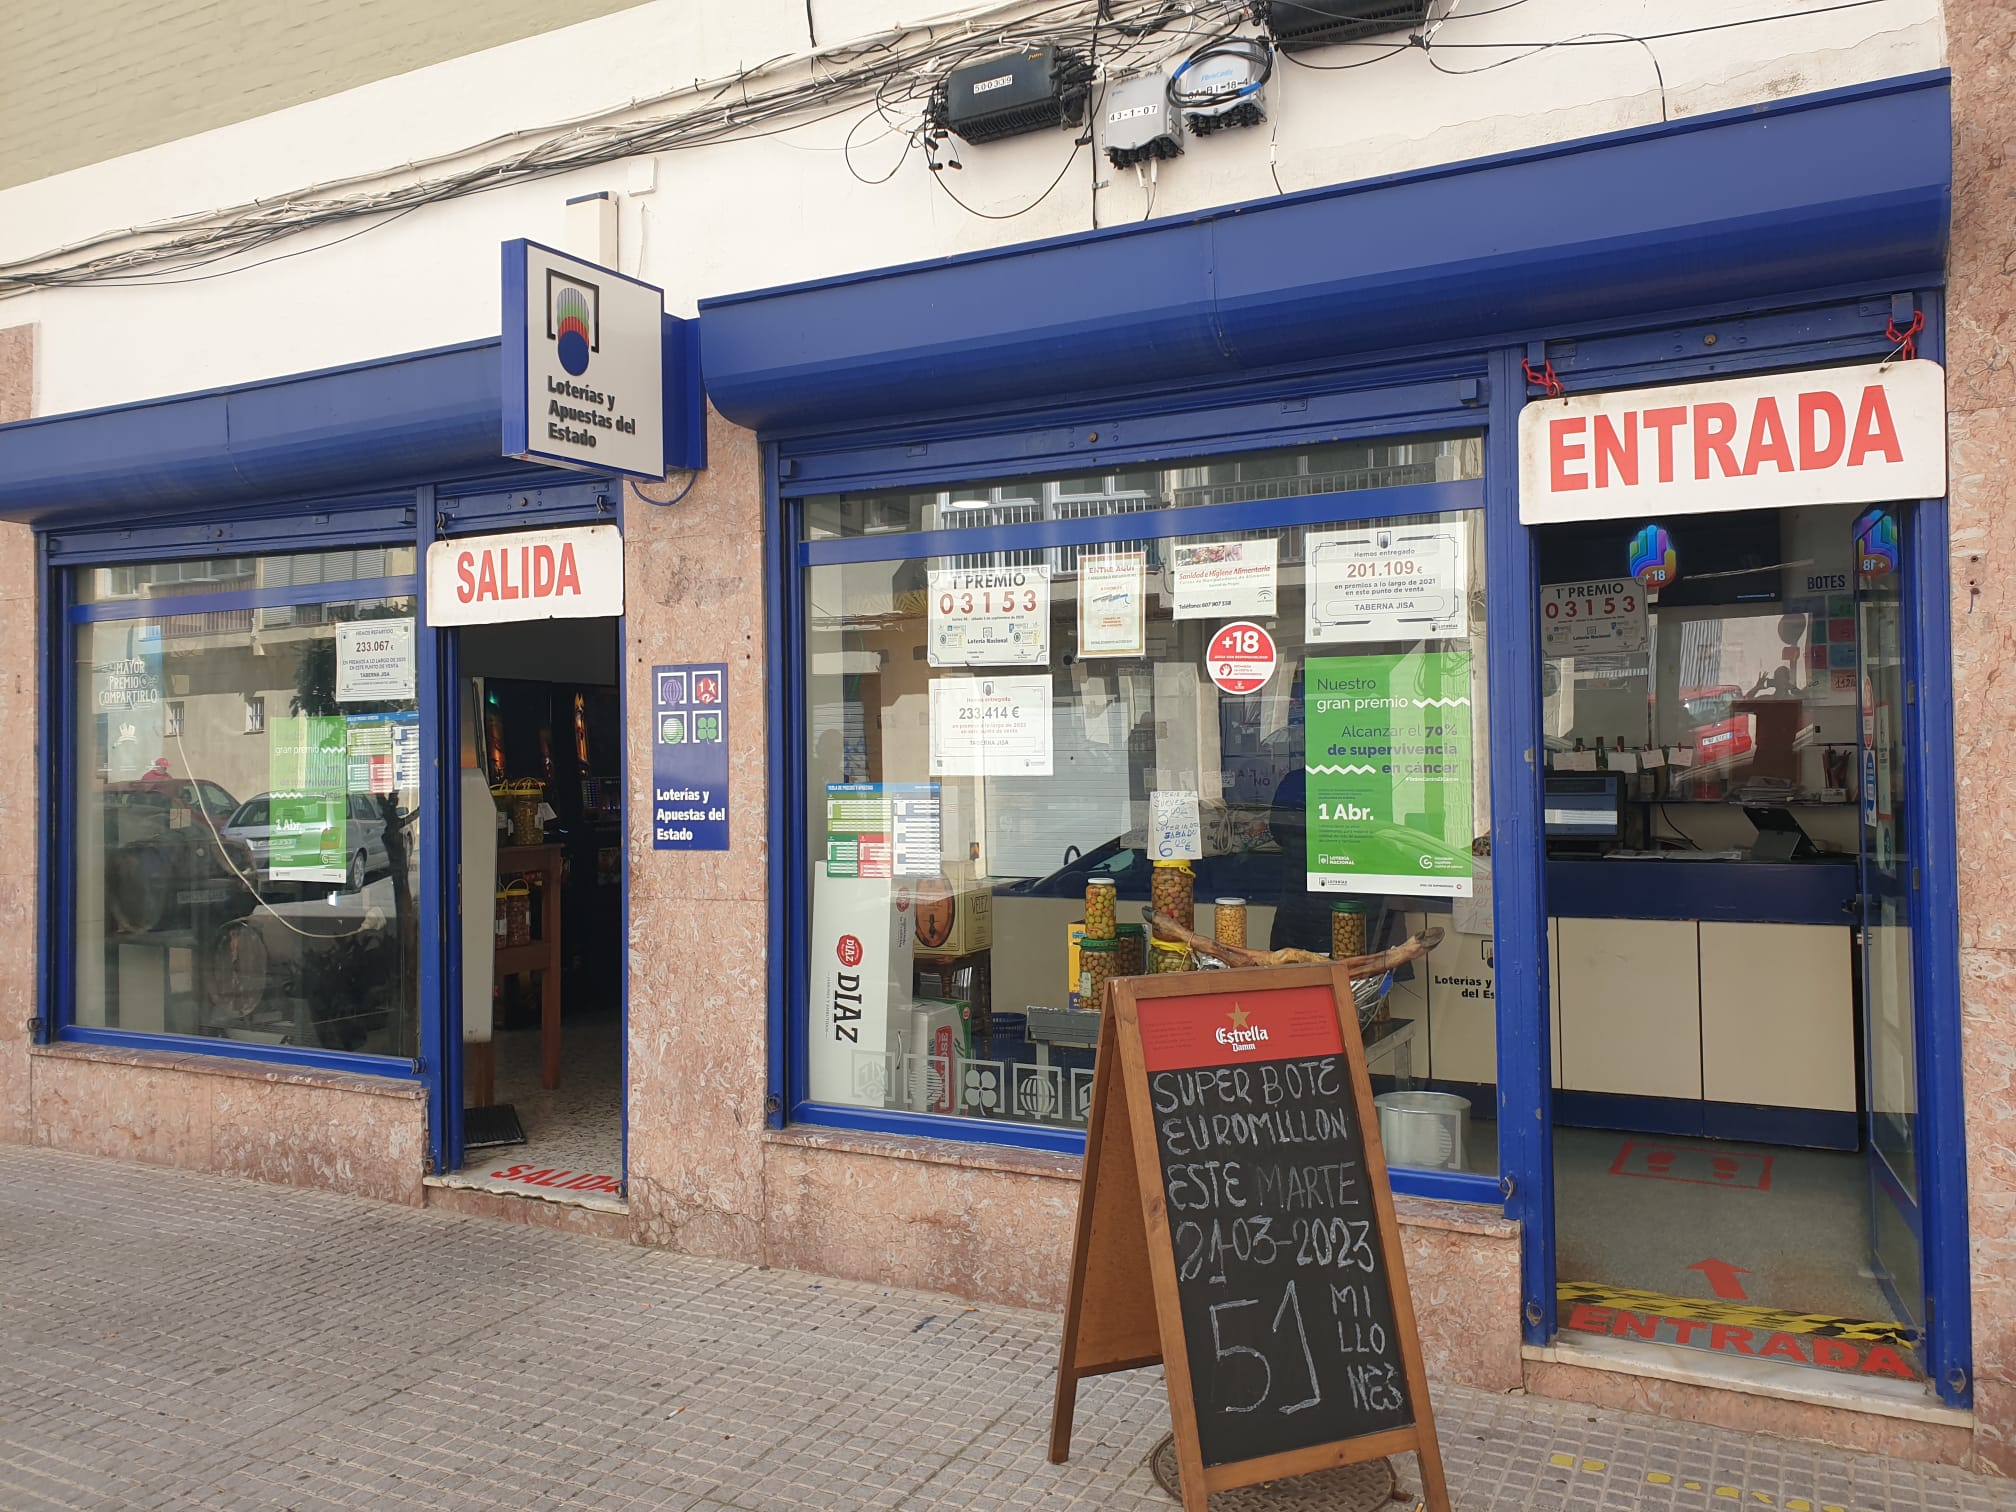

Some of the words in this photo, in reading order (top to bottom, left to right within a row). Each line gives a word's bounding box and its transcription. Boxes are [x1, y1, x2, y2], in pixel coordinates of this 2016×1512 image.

[1110, 105, 1157, 121] 43-1-07
[547, 375, 604, 405] Loterías
[607, 393, 615, 412] y
[548, 400, 613, 430] Apuestas
[616, 414, 636, 435] del
[548, 421, 597, 448] Estado
[1549, 384, 1904, 493] ENTRADA
[1379, 548, 1415, 557] entregado
[456, 542, 581, 604] SALIDA
[1179, 571, 1205, 580] Sanidad
[1209, 569, 1232, 578] Higiene
[1233, 565, 1270, 575] Alimentaria
[1347, 560, 1415, 579] 201.109
[1417, 566, 1423, 574] €
[966, 573, 1026, 589] PREMIO
[1344, 582, 1372, 591] premios
[1388, 580, 1407, 588] largo
[1807, 575, 1846, 590] BOTES
[1371, 588, 1392, 596] punto
[1568, 583, 1624, 598] PREMIO
[940, 590, 1037, 615] 03153
[1355, 602, 1394, 611] TABERNA
[1396, 601, 1414, 609] JISA
[1545, 595, 1636, 619] 03153
[356, 640, 389, 653] 233.067
[1222, 630, 1259, 654] +18
[116, 660, 145, 675] MAYOR
[109, 675, 139, 690] PREMIO
[1317, 678, 1377, 691] Nuestro
[98, 689, 158, 706] COMPARTIRLO
[1317, 699, 1350, 713] gran
[1354, 695, 1409, 712] premio
[959, 706, 1008, 720] 233.414
[1012, 706, 1020, 718] €
[1341, 725, 1405, 738] Alcanzar
[1408, 723, 1421, 737] el
[1425, 723, 1458, 738] 70%
[1327, 743, 1347, 756] de
[1350, 745, 1458, 758] supervivencia
[1381, 764, 1401, 774] en
[1404, 761, 1459, 774] cáncer
[657, 788, 700, 800] Loterías
[703, 790, 709, 804] y
[657, 808, 706, 823] Apuestas
[708, 808, 726, 820] del
[1318, 804, 1330, 820] 1
[1333, 803, 1374, 820] Abr.
[275, 819, 282, 830] 1
[283, 818, 302, 832] Abr.
[657, 828, 693, 841] Estado
[845, 938, 855, 962] DIAZ
[1485, 978, 1492, 990] y
[1461, 989, 1479, 999] del
[833, 972, 862, 1043] DIAZ
[1215, 1025, 1269, 1045] Estrella
[1232, 1043, 1256, 1052] Damm
[1154, 1068, 1252, 1113] SUPER
[1260, 1058, 1339, 1105] BOTE
[1162, 1104, 1348, 1155] EUROMILLON
[490, 1164, 623, 1193] SALIDA
[1167, 1161, 1246, 1211] ESTE
[1257, 1160, 1359, 1212] MARTE
[1175, 1214, 1375, 1284] 21-03-2023
[1329, 1283, 1371, 1318] MI
[1338, 1320, 1386, 1354] LLO
[1569, 1305, 1915, 1378] ENTRADA
[1209, 1279, 1321, 1415] 51
